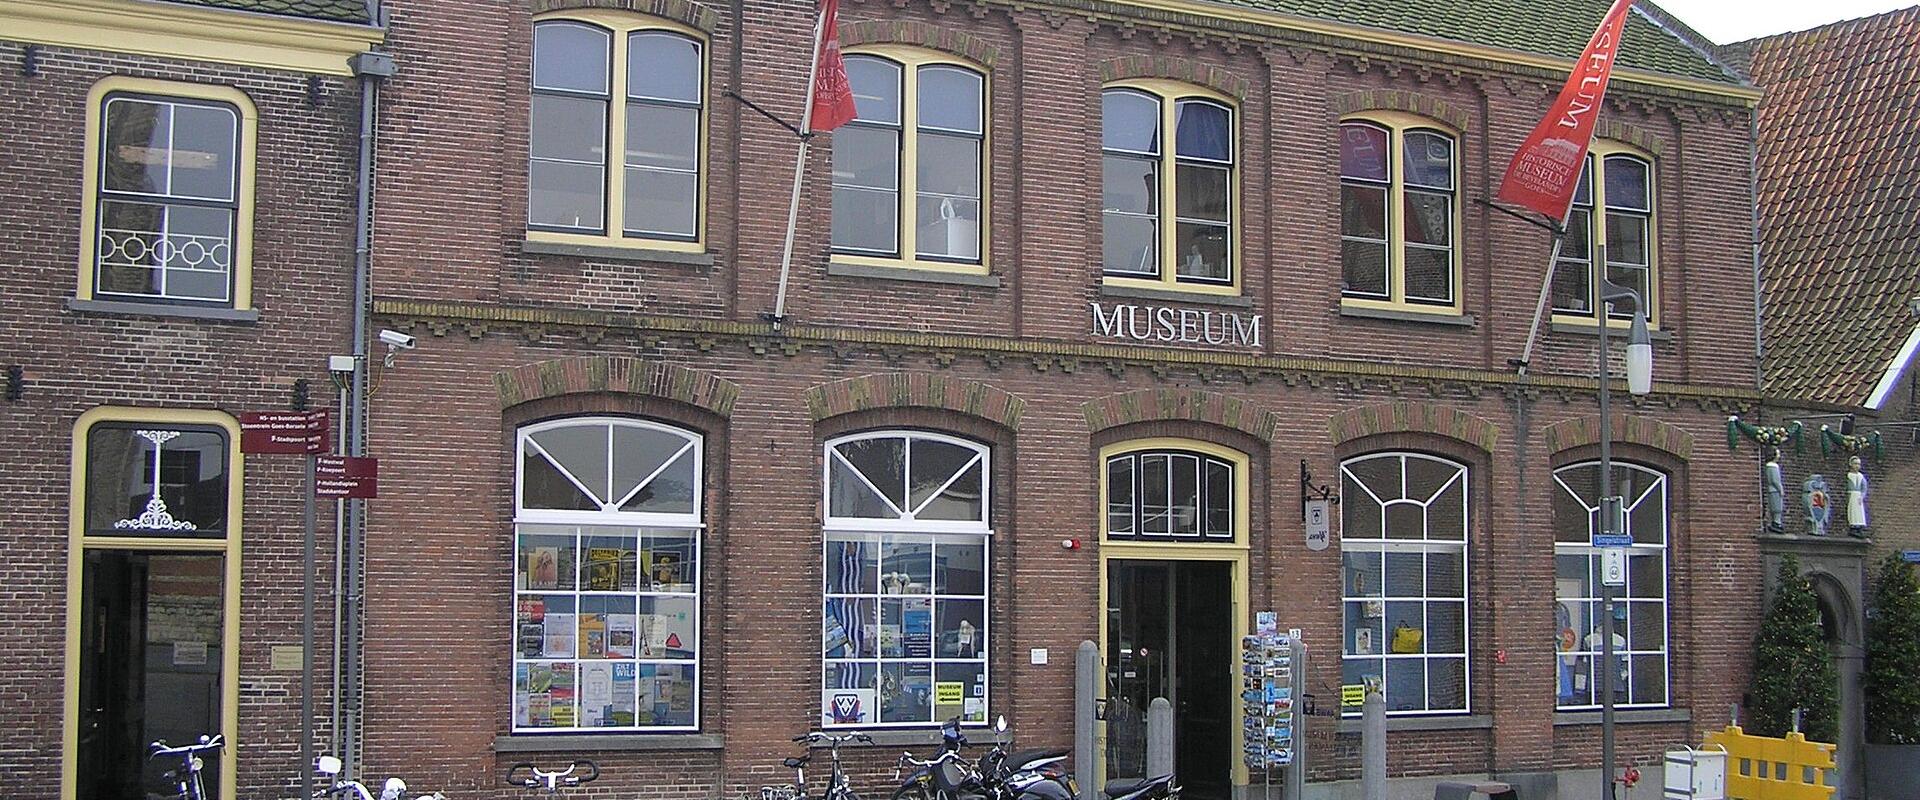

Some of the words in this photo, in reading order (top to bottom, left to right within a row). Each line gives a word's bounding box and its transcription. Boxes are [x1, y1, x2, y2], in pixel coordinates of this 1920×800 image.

[1515, 160, 1568, 188] MUSEUM
[1090, 302, 1263, 347] MUSEUM
[1290, 629, 1300, 639] 13
[836, 697, 855, 715] VVV
